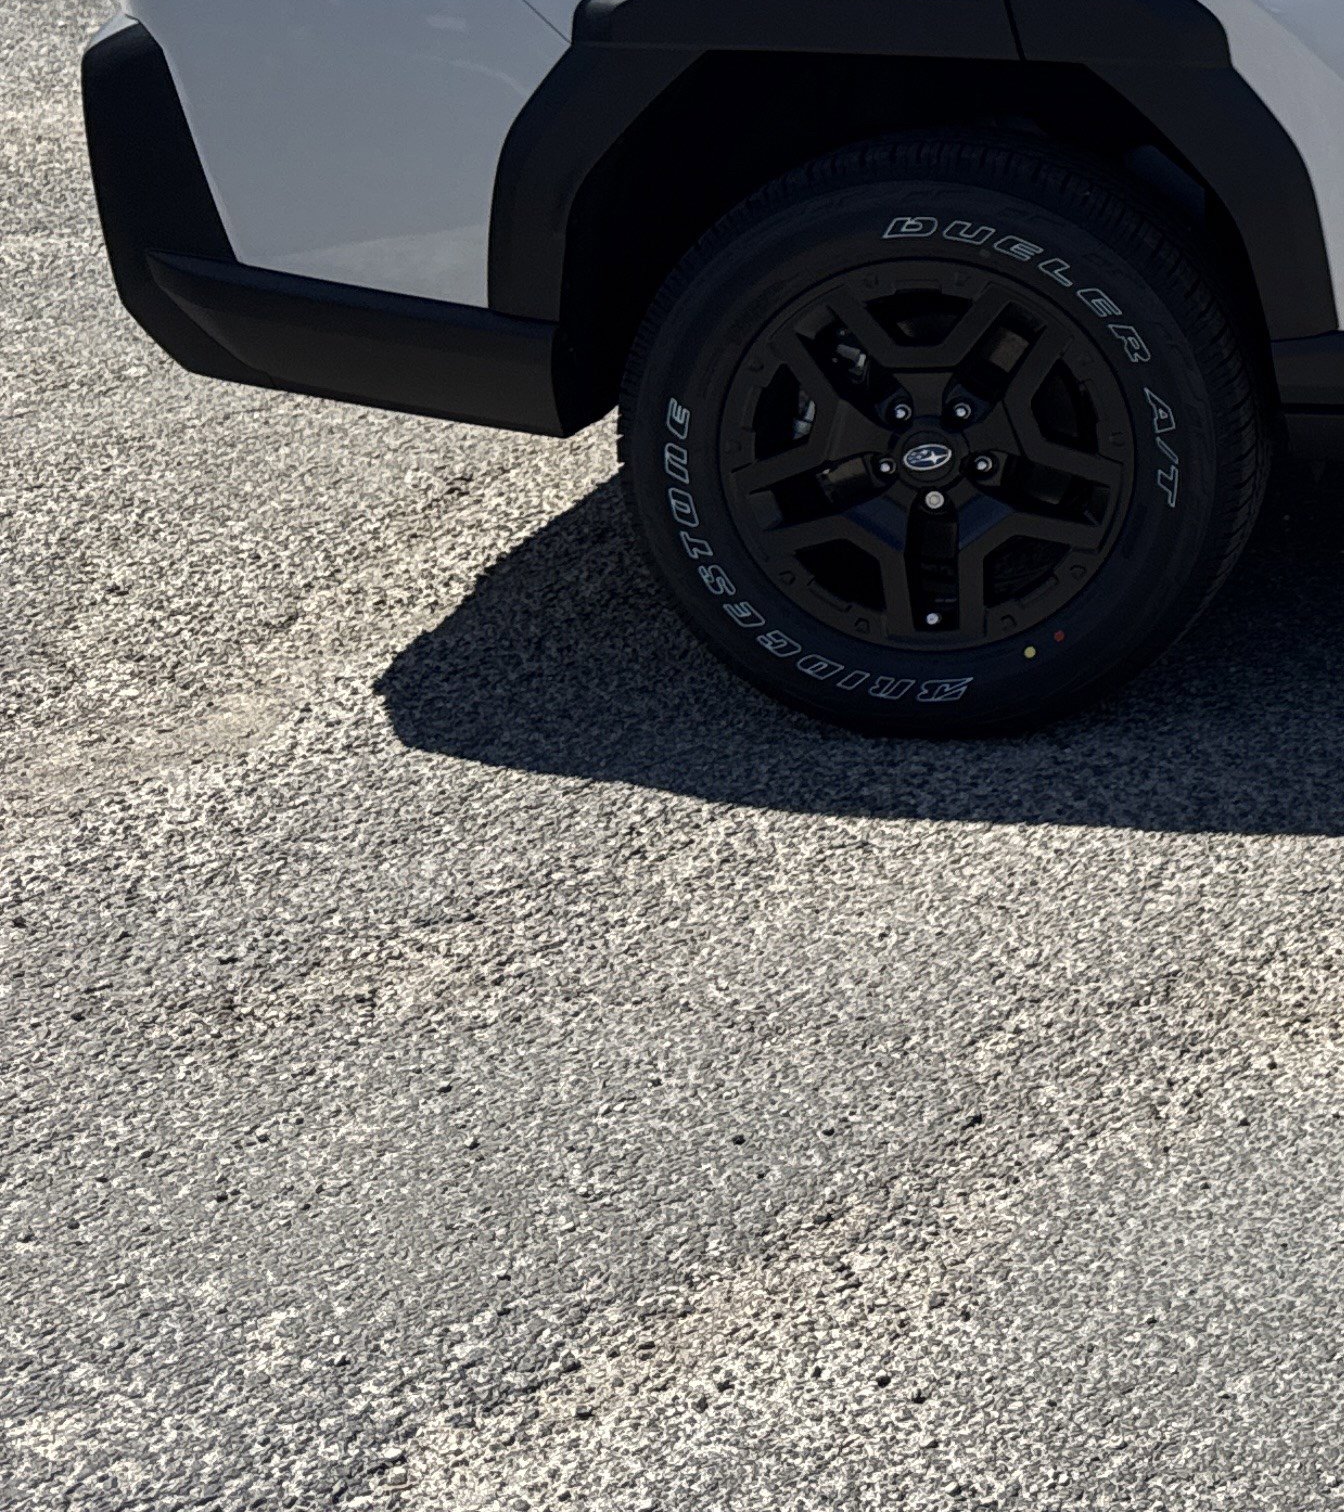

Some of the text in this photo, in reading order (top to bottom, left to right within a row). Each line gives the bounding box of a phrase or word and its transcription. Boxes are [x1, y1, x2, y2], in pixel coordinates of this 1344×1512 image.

[882, 215, 1180, 509] DUELER A/T
[663, 397, 976, 703] BRIDGESTONE
